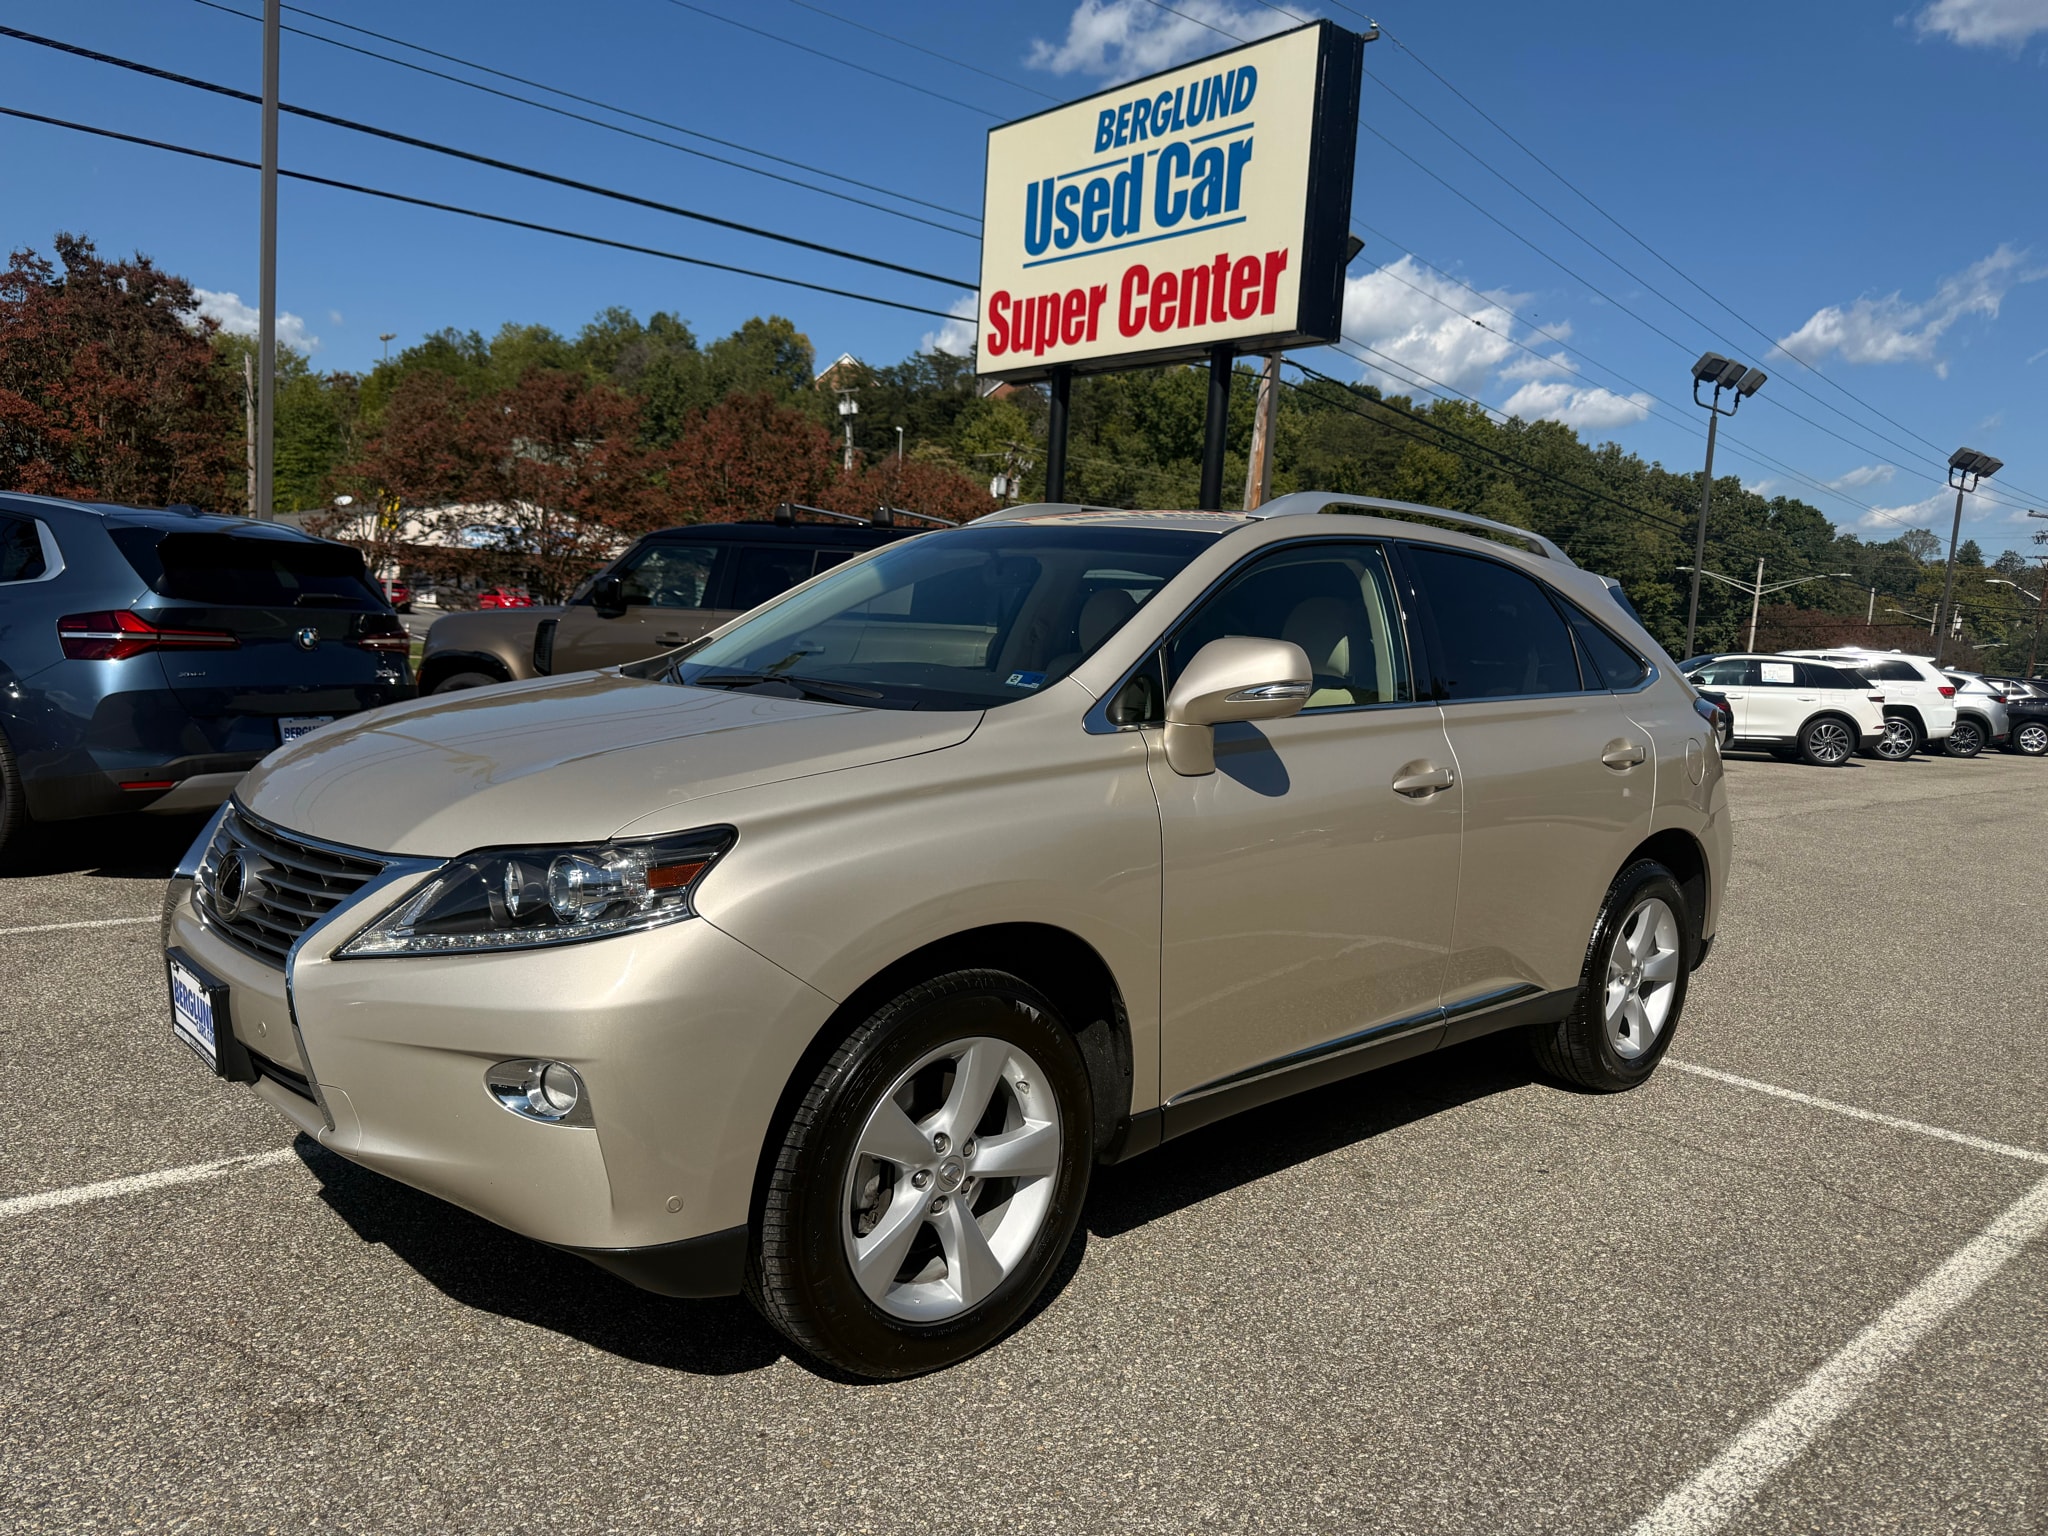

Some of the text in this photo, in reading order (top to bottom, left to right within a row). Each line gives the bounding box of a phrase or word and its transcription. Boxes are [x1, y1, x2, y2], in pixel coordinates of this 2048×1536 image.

[1094, 65, 1258, 154] BERGLUND
[1024, 135, 1254, 256] Used Car
[987, 247, 1289, 357] Super Center
[284, 725, 321, 739] BERG
